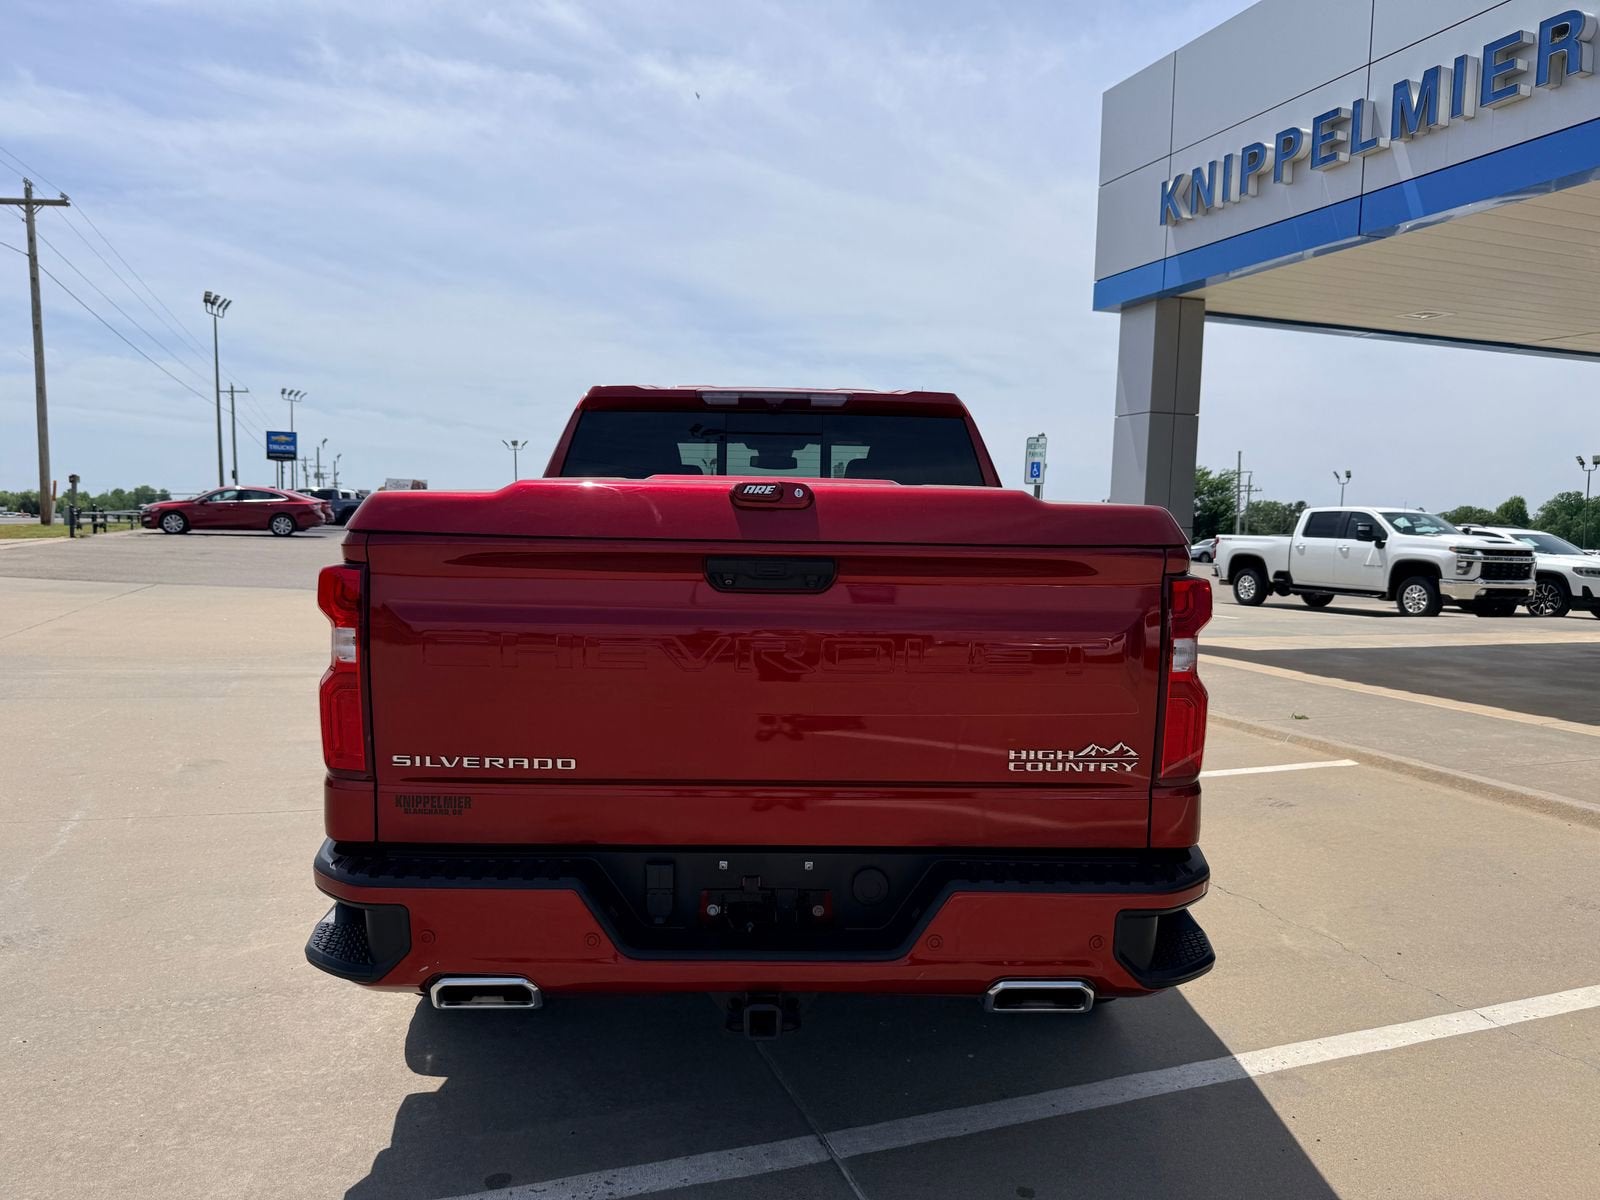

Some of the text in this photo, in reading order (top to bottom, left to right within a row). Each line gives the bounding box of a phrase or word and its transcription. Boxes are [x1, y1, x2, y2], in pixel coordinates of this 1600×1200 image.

[1160, 10, 1597, 226] KNIPPELMIER
[743, 485, 776, 494] ARE
[422, 629, 1111, 674] CHEVROLET
[1009, 750, 1074, 760] HIGH
[392, 755, 577, 770] SILVERADO
[1008, 762, 1138, 772] COUNTRY
[395, 794, 472, 808] KNIPPELMIER
